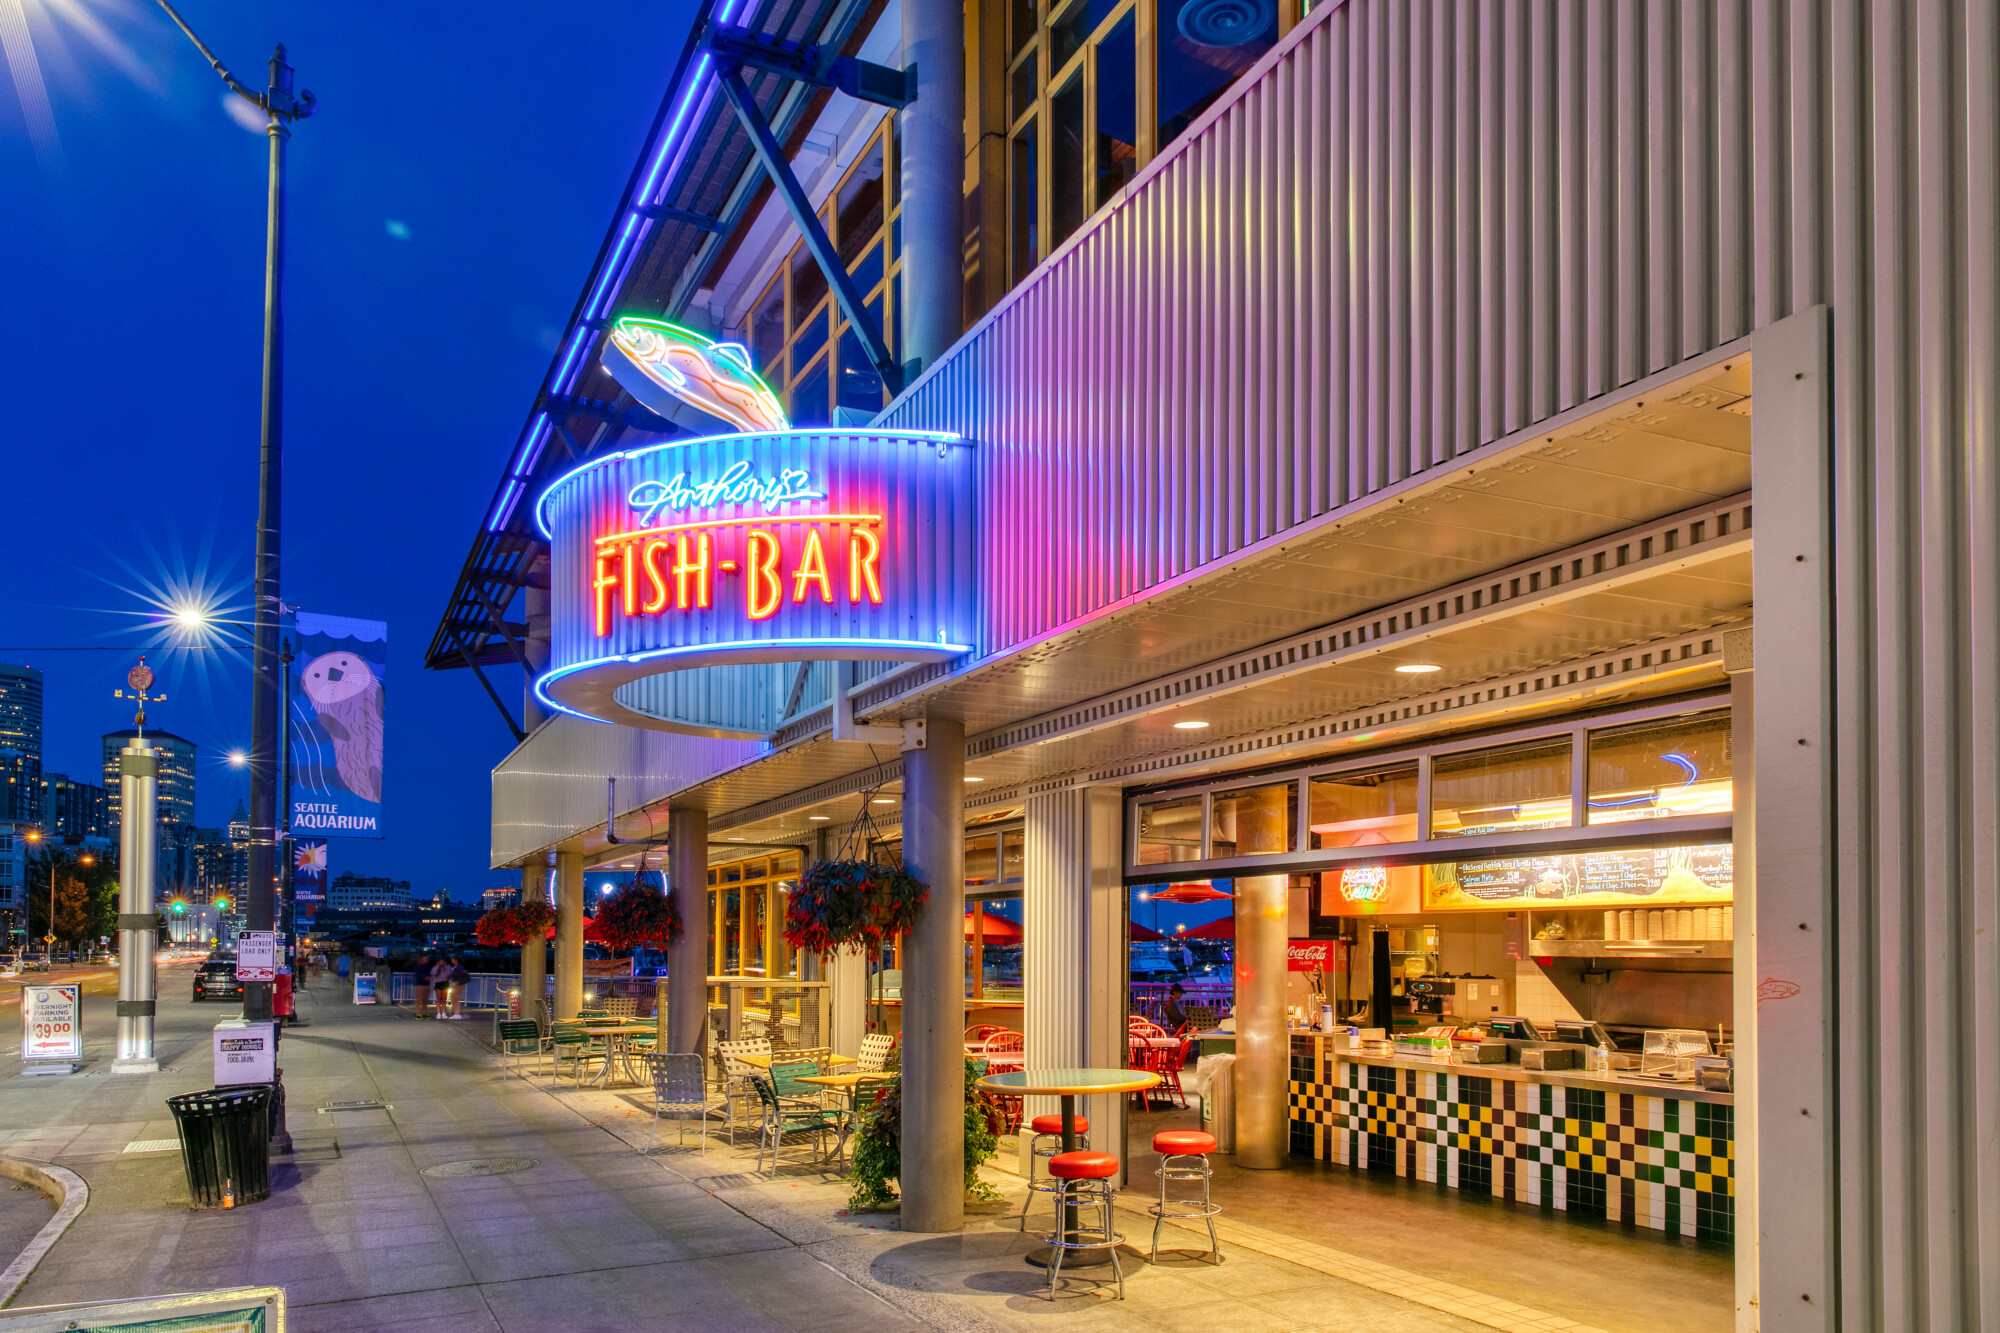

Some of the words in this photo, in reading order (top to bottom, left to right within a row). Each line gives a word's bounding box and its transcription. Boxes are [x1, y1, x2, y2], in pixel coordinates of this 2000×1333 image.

[629, 461, 826, 527] Anthony's
[294, 803, 338, 814] SEATTLE
[294, 814, 377, 830] AQUARIUM
